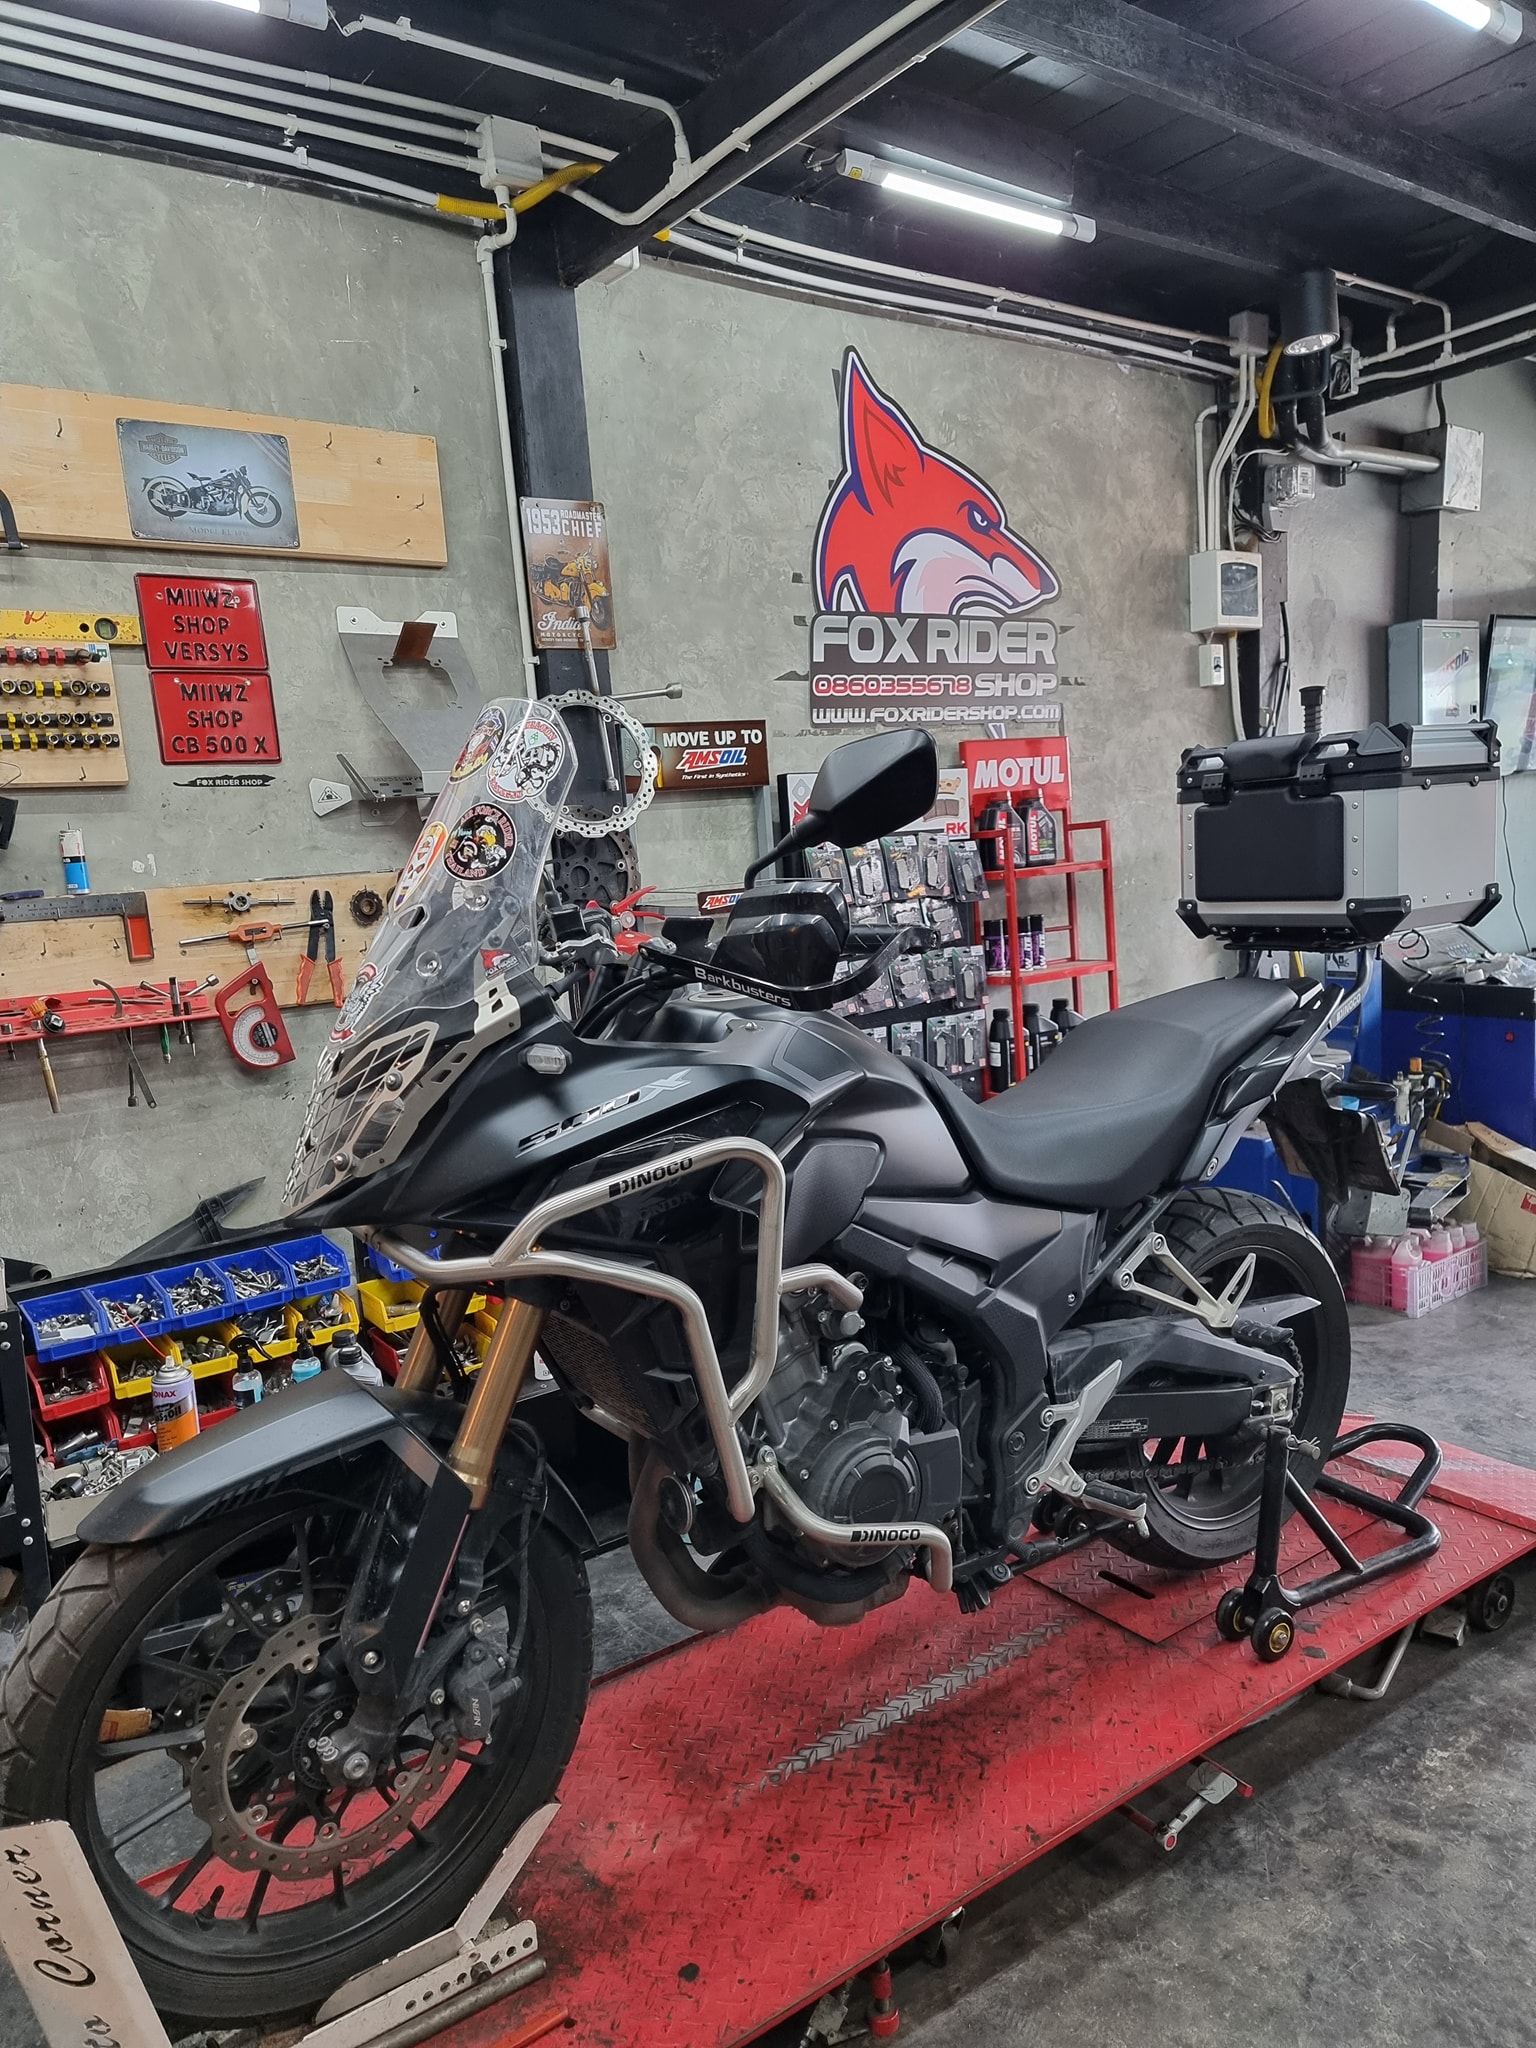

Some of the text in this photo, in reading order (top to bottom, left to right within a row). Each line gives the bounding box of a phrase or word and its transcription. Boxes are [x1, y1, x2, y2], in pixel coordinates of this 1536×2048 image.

[526, 508, 560, 535] 1953
[560, 510, 601, 521] ROADMASTER
[562, 520, 602, 538] CHIEF
[165, 588, 236, 608] MIIWZ
[174, 615, 230, 635] SHOP
[537, 611, 582, 630] India
[812, 615, 1056, 664] FOX RIDER
[164, 642, 249, 662] VERSYS
[180, 683, 248, 702] MIIWZ
[813, 673, 1057, 697] 0860355678 SHOP
[188, 710, 243, 728] SHOP
[172, 736, 268, 754] CB 500 X
[663, 729, 762, 747] MOVE UP TO
[677, 748, 746, 771] AMSOIL
[241, 778, 263, 786] SHOP
[974, 756, 1064, 789] MOTUL
[945, 822, 968, 835] RK
[1030, 815, 1038, 851] MOTUL
[694, 966, 792, 1008] Barkbusters
[609, 1157, 693, 1198] DINOCO
[153, 1390, 176, 1399] ONAX
[850, 1528, 921, 1543] DINOCO
